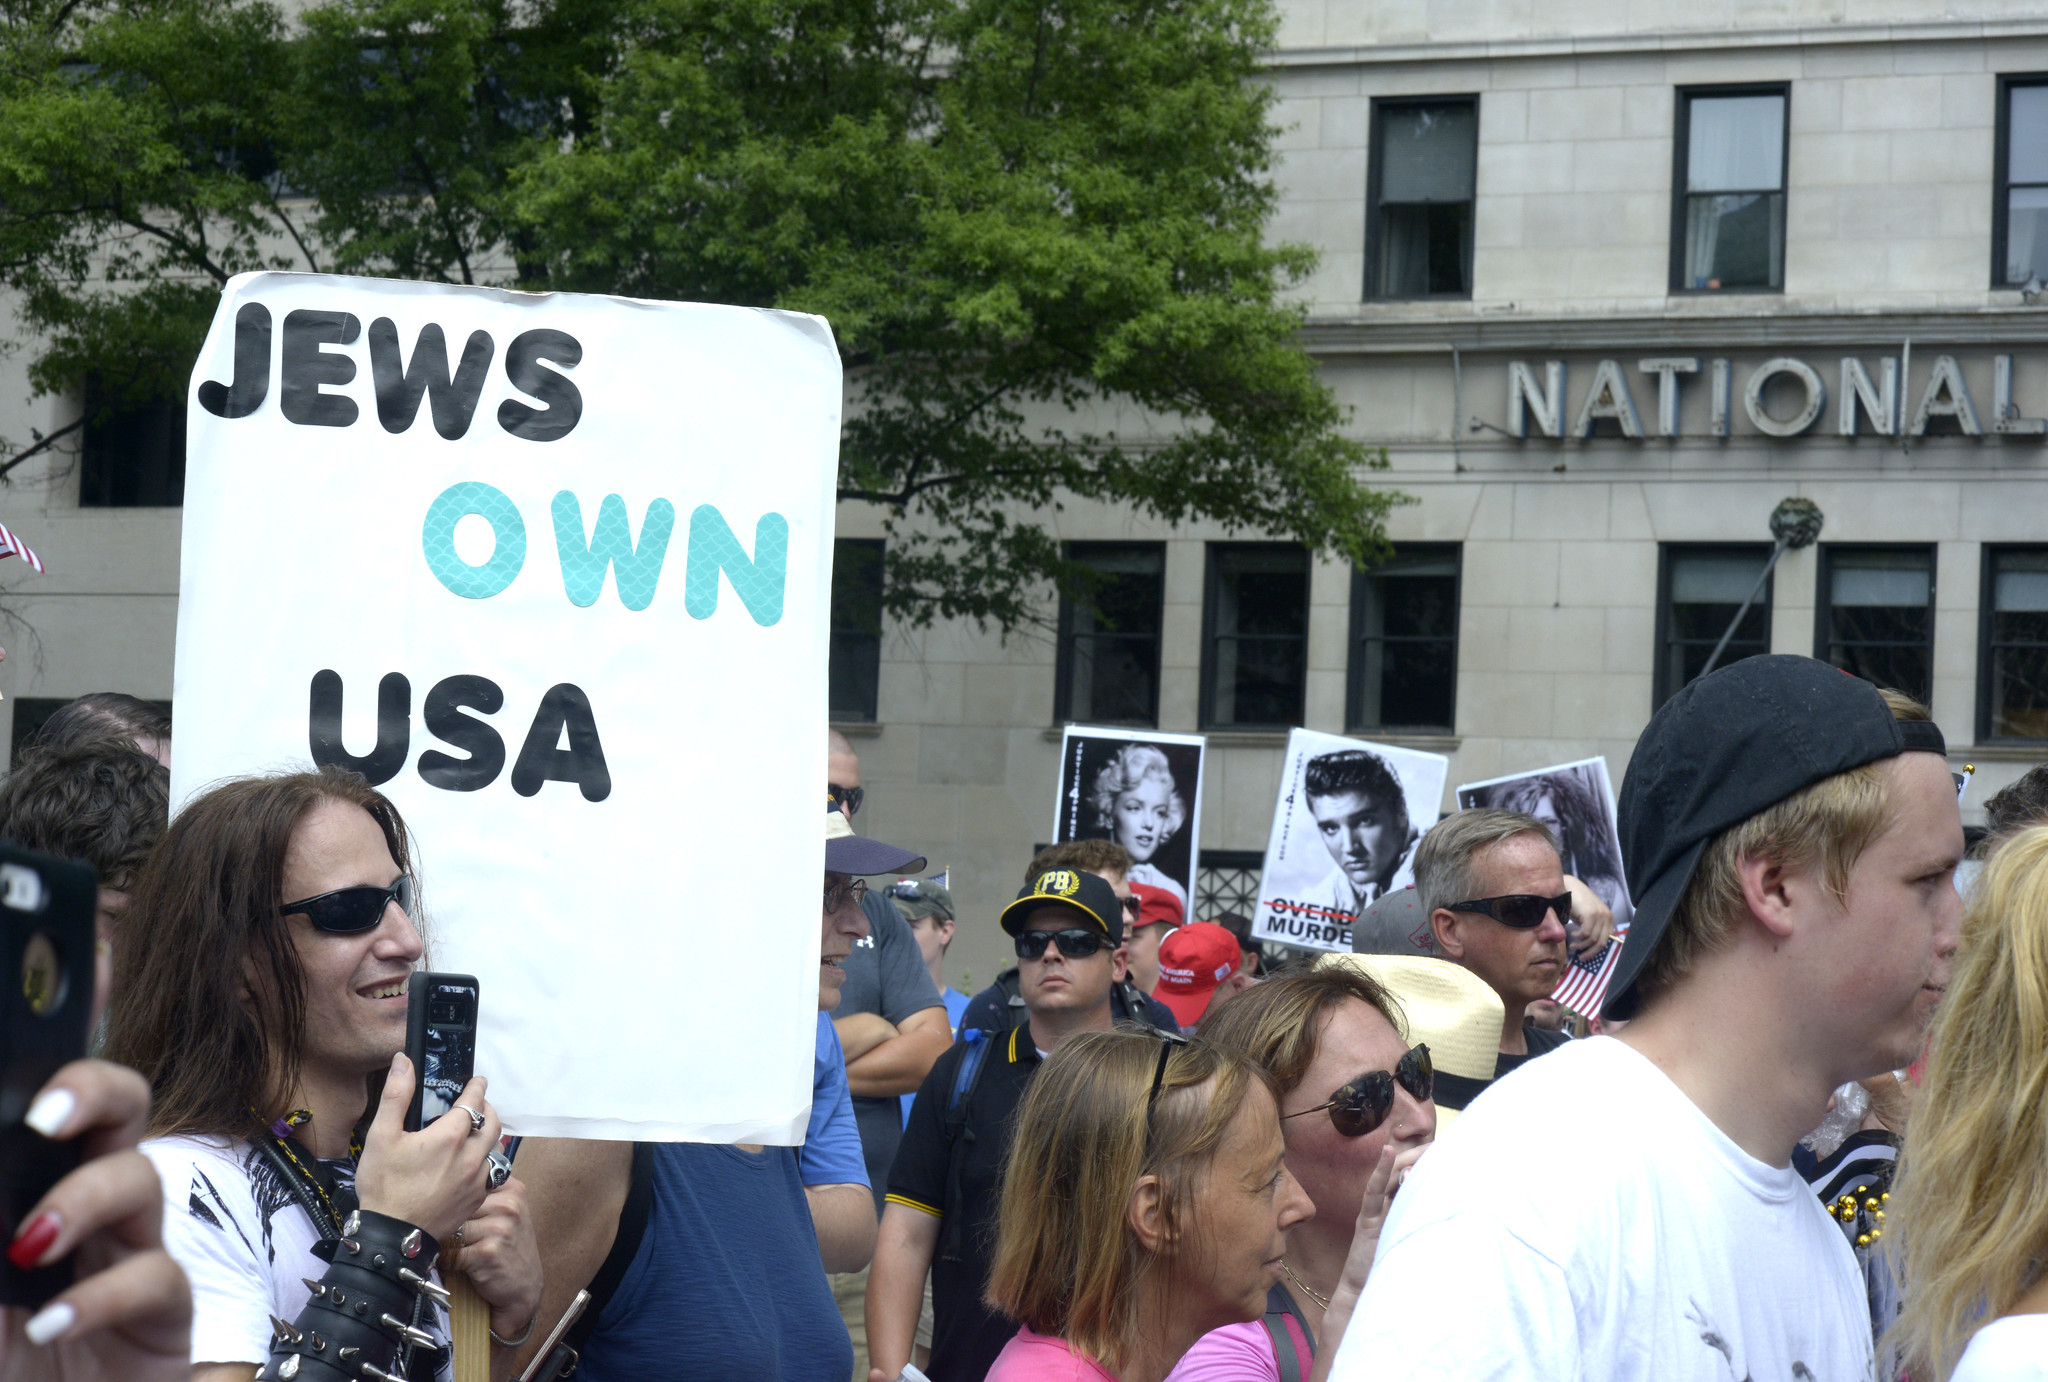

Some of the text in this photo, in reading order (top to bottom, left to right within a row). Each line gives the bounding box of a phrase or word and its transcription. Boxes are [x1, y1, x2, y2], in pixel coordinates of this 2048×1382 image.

[198, 302, 583, 442] JEWS
[1507, 354, 2047, 438] NATIONAL
[422, 481, 789, 627] OWN
[310, 669, 612, 803] USA
[1041, 871, 1070, 892] PB
[1272, 898, 1359, 926] OVERD
